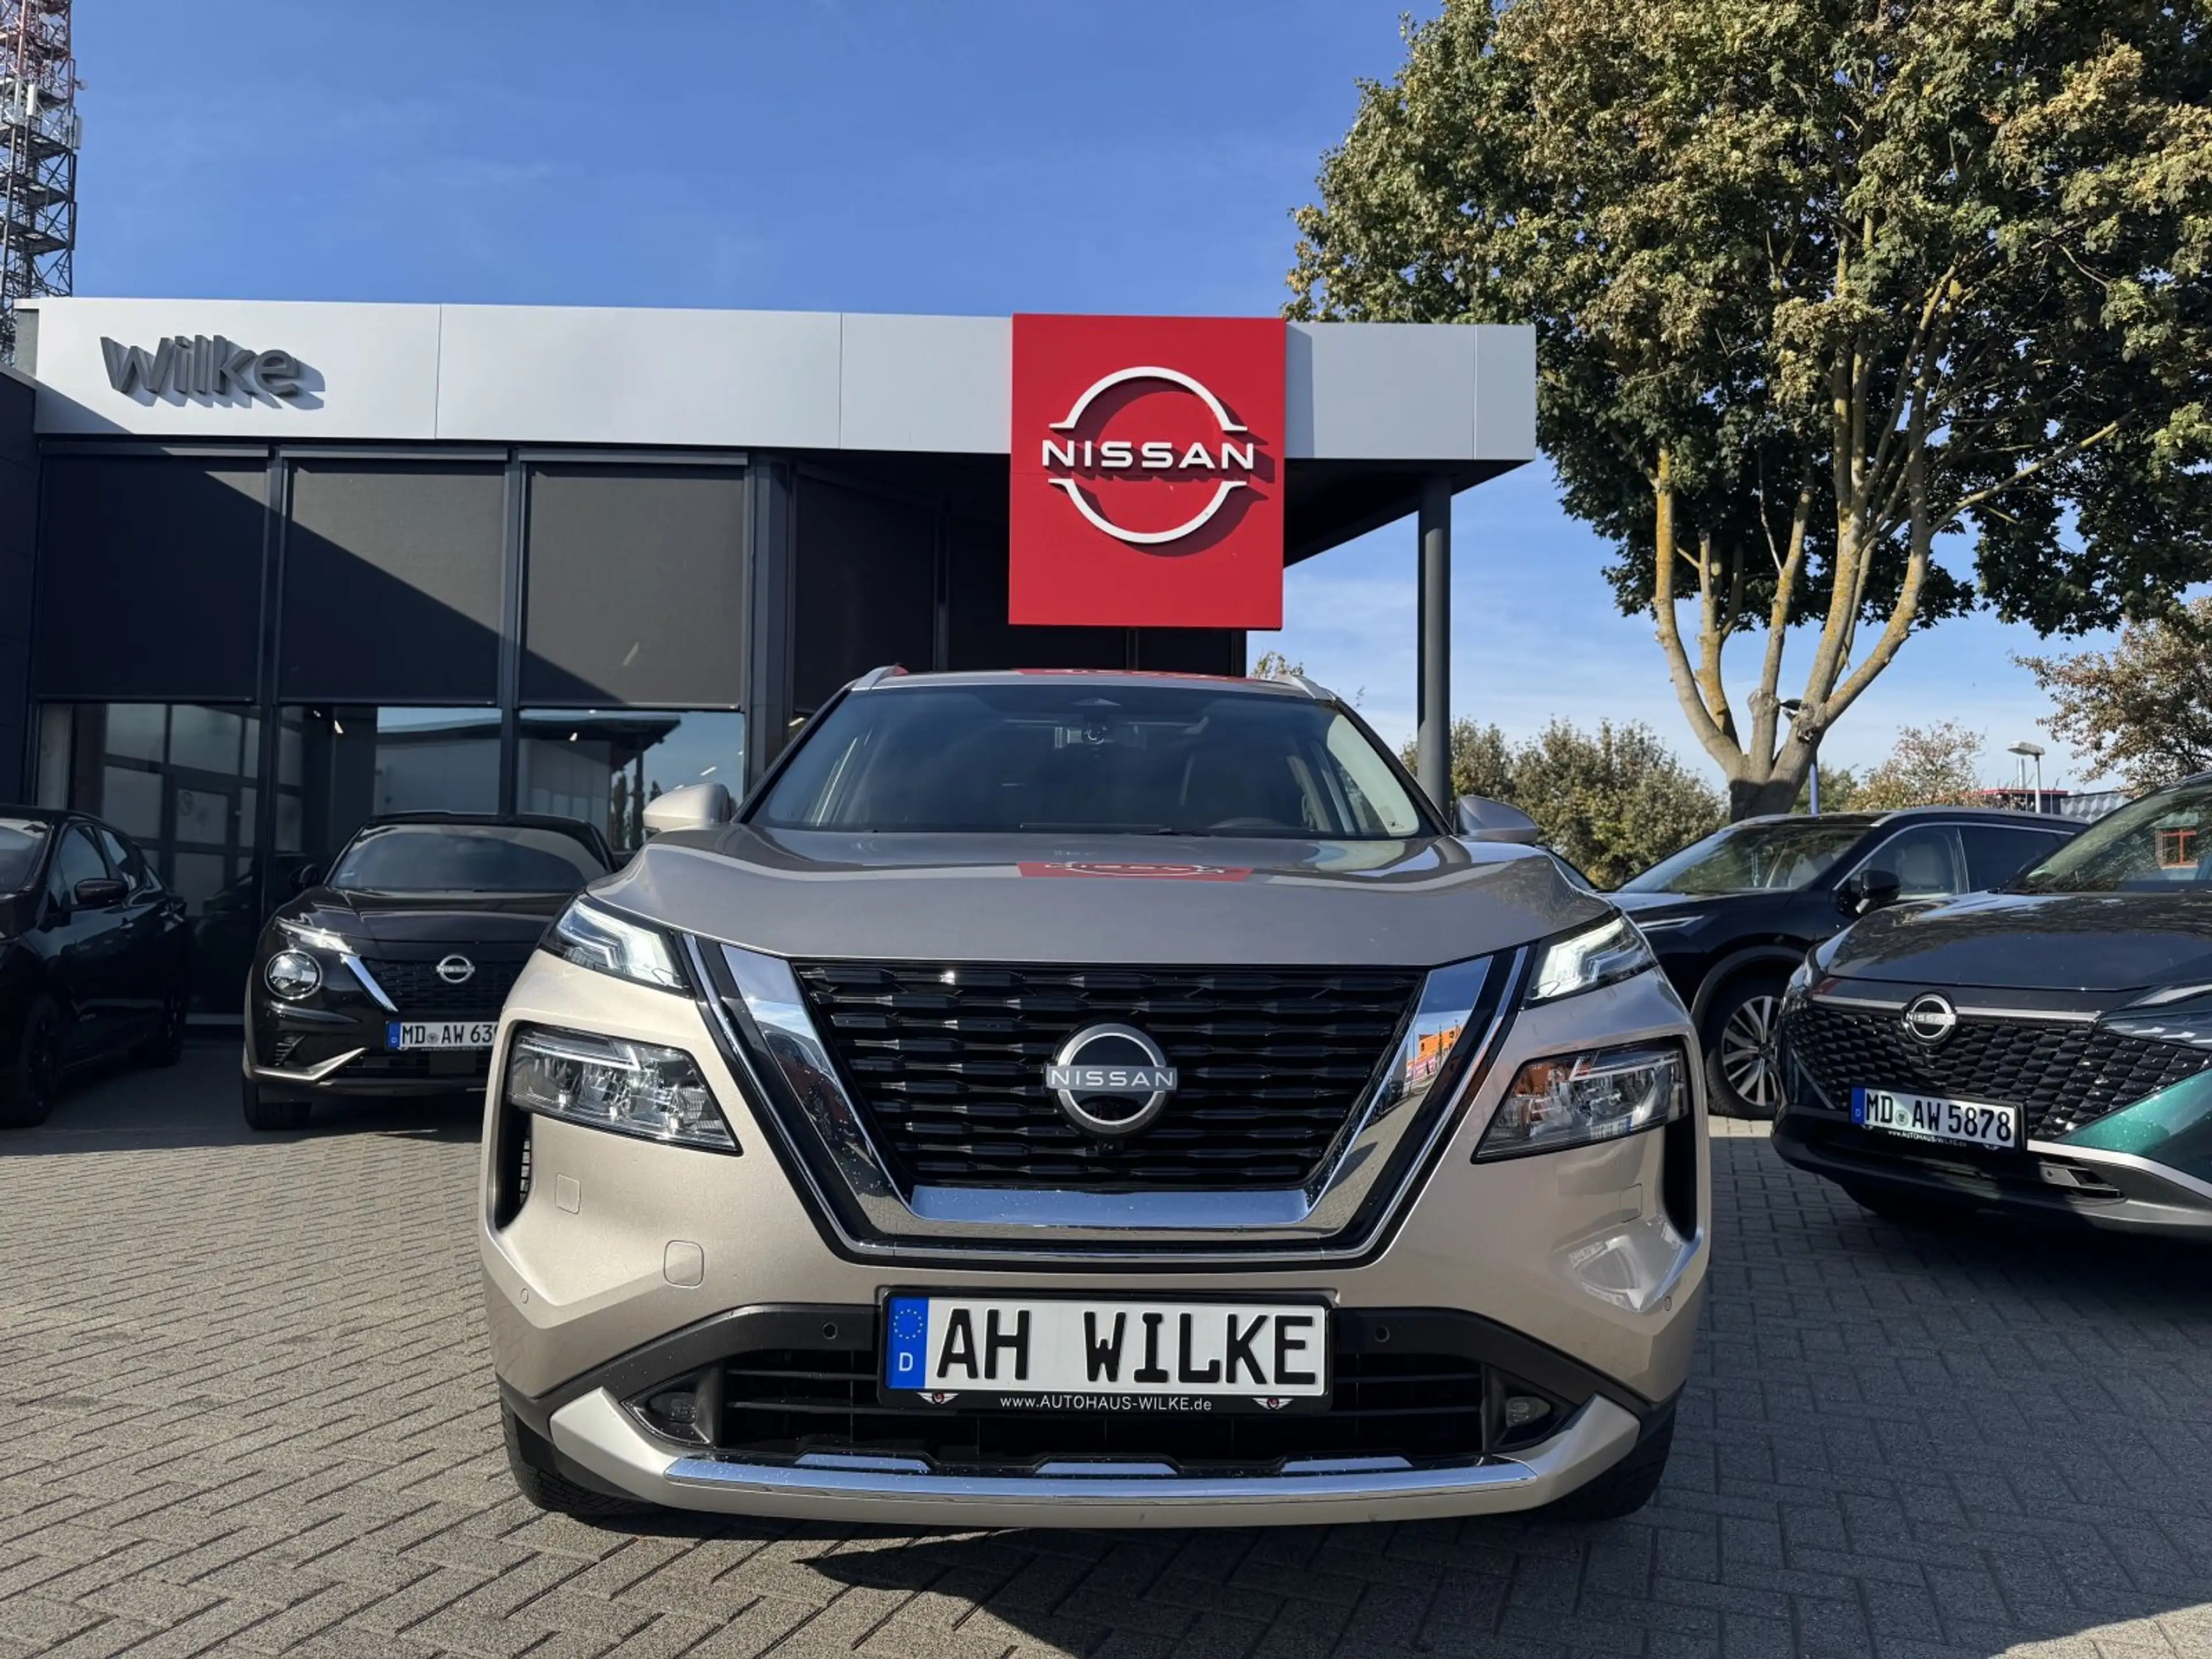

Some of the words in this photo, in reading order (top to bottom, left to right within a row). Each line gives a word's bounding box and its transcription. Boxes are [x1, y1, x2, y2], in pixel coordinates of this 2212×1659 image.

[100, 335, 302, 397] Wilke
[1041, 440, 1255, 469] NISSAN
[1906, 1012, 1956, 1025] NISSAN
[403, 1025, 426, 1044] MD
[441, 1025, 464, 1044] AW
[470, 1024, 499, 1044] 63
[1051, 1070, 1173, 1086] NISSAN
[1855, 1108, 1861, 1117] D
[1866, 1093, 1893, 1124] MD
[1912, 1100, 1941, 1131] AW
[1948, 1104, 2012, 1142] 5878
[935, 1308, 1030, 1380] AH
[1083, 1311, 1316, 1385] WILKE
[899, 1352, 914, 1372] D
[999, 1395, 1212, 1411] www.AUTOHAUS-WILKE.de
